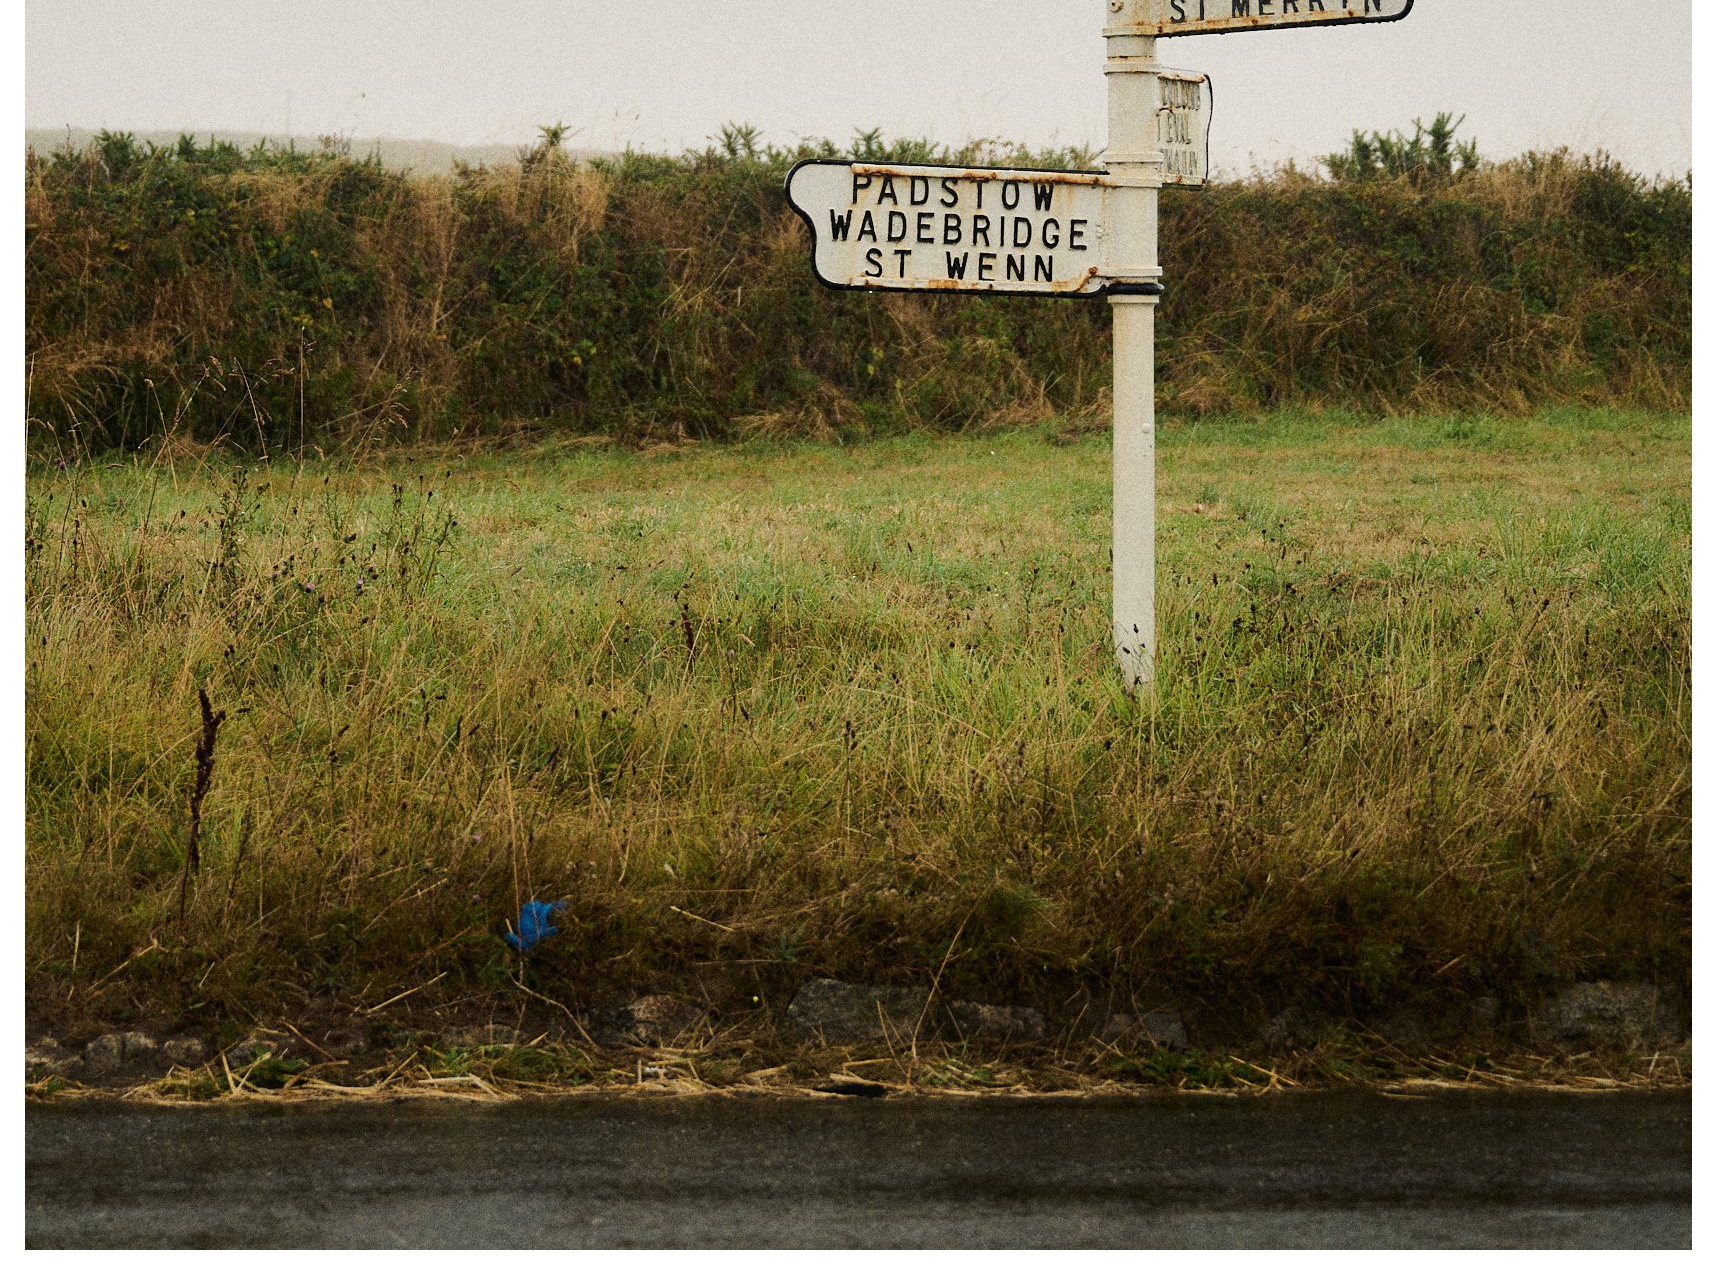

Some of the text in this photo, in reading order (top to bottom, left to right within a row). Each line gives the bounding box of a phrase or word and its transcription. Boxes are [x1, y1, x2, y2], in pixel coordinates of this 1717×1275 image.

[851, 174, 1055, 212] PADSTOW
[829, 208, 1089, 251] WADEBRIDGE
[864, 247, 1055, 283] ST WENN
